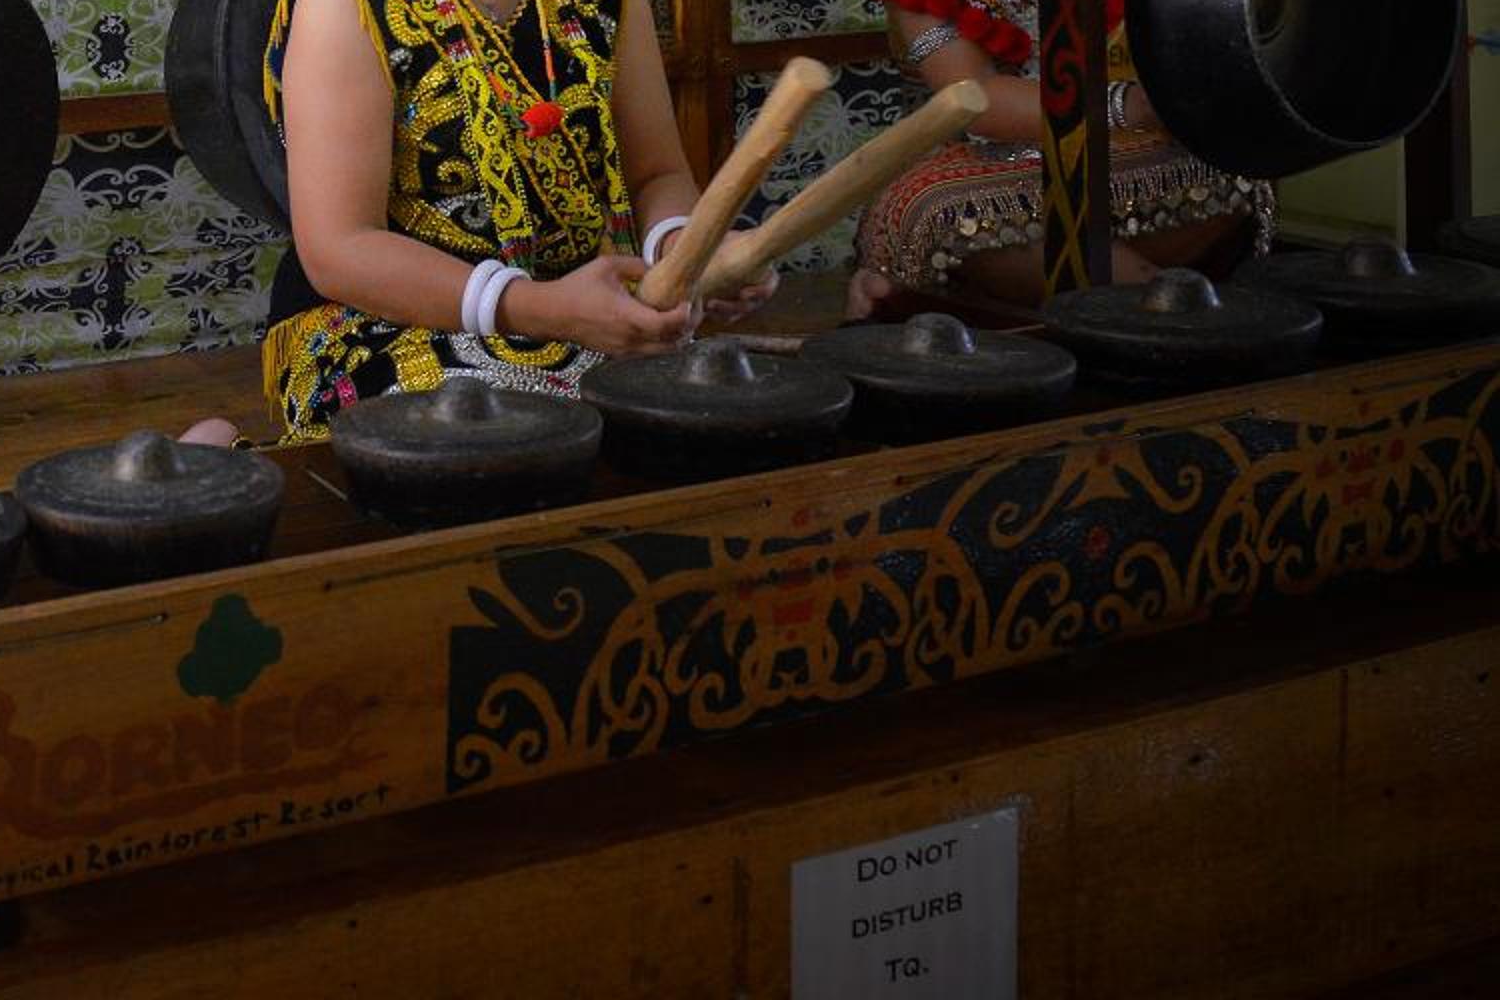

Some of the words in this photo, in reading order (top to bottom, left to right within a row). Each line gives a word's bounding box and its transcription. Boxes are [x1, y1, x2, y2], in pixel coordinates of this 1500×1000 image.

[857, 856, 897, 883] DO
[905, 839, 959, 871] NOT
[851, 891, 964, 939] DISTURB
[885, 957, 929, 983] TQ.
